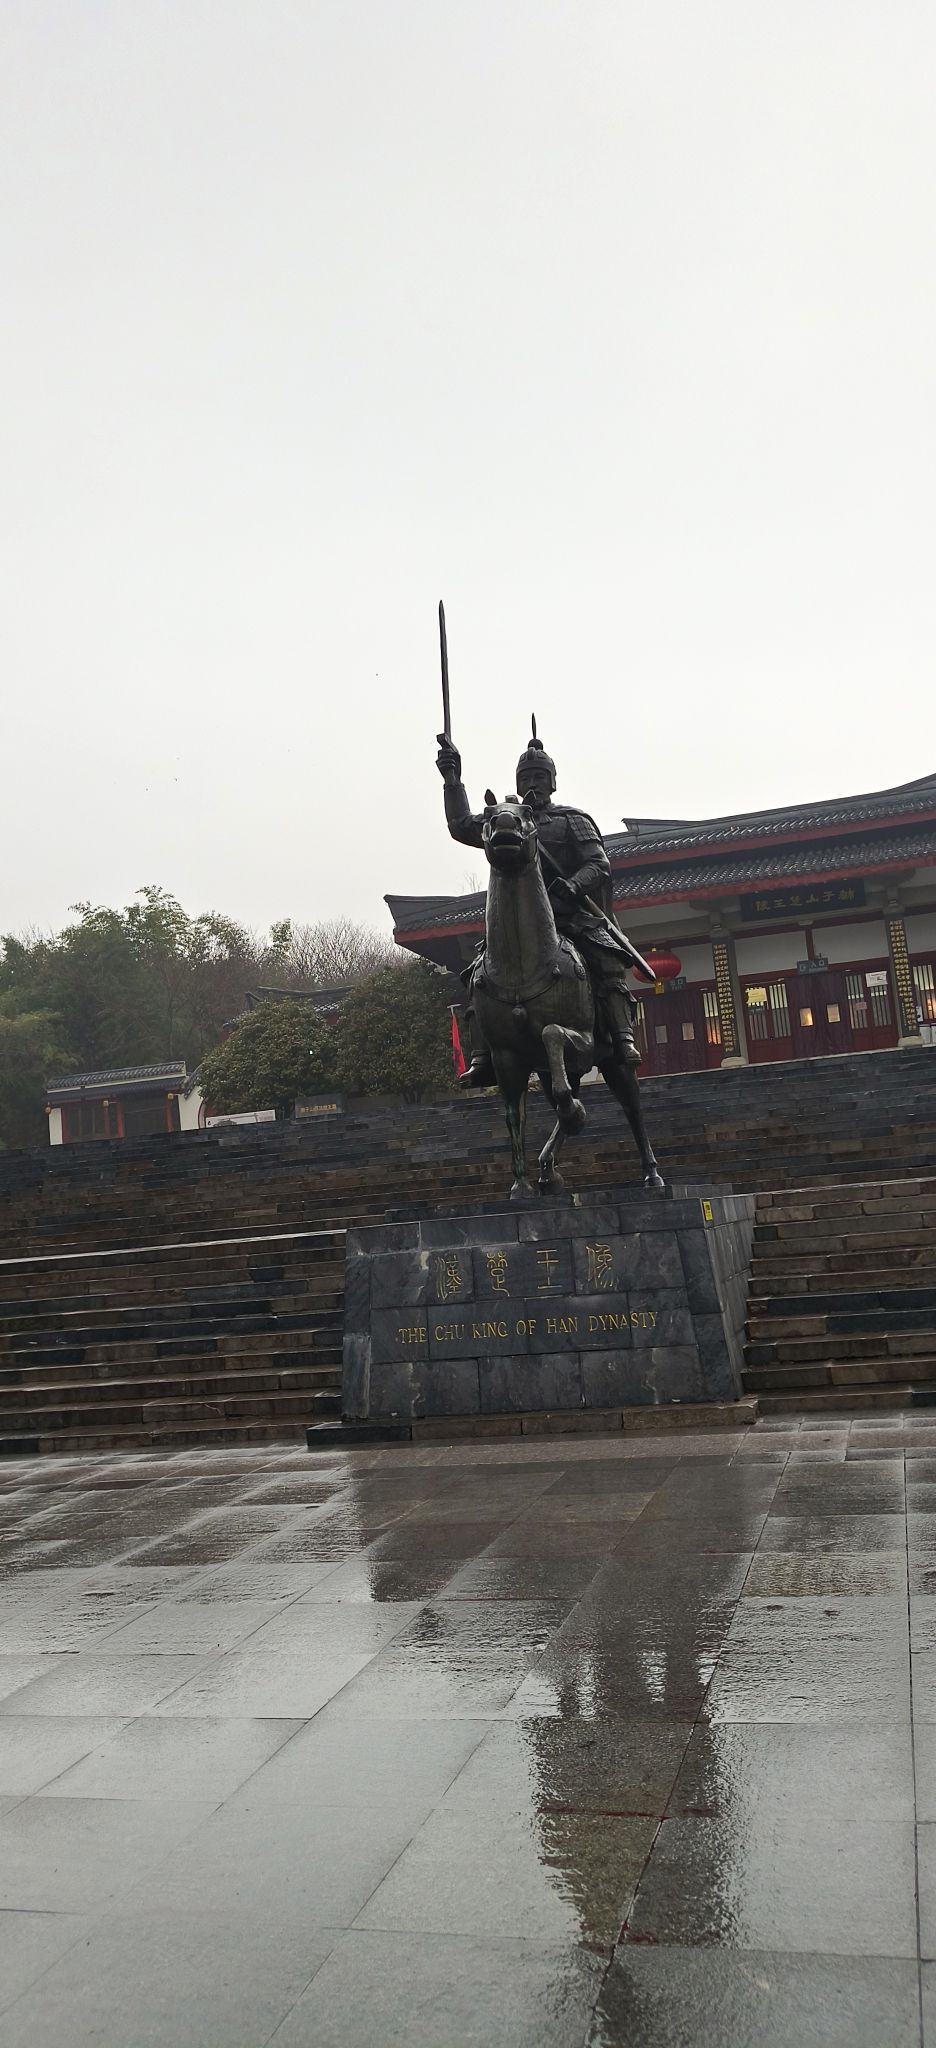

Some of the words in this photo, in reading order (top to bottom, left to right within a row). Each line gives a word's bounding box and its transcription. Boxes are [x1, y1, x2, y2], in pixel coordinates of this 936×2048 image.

[399, 1327, 428, 1344] THE
[435, 1325, 465, 1342] CHU
[472, 1321, 509, 1339] KING
[516, 1319, 537, 1335] OF
[547, 1317, 578, 1334] HAN
[589, 1311, 659, 1332] DYNASTY
